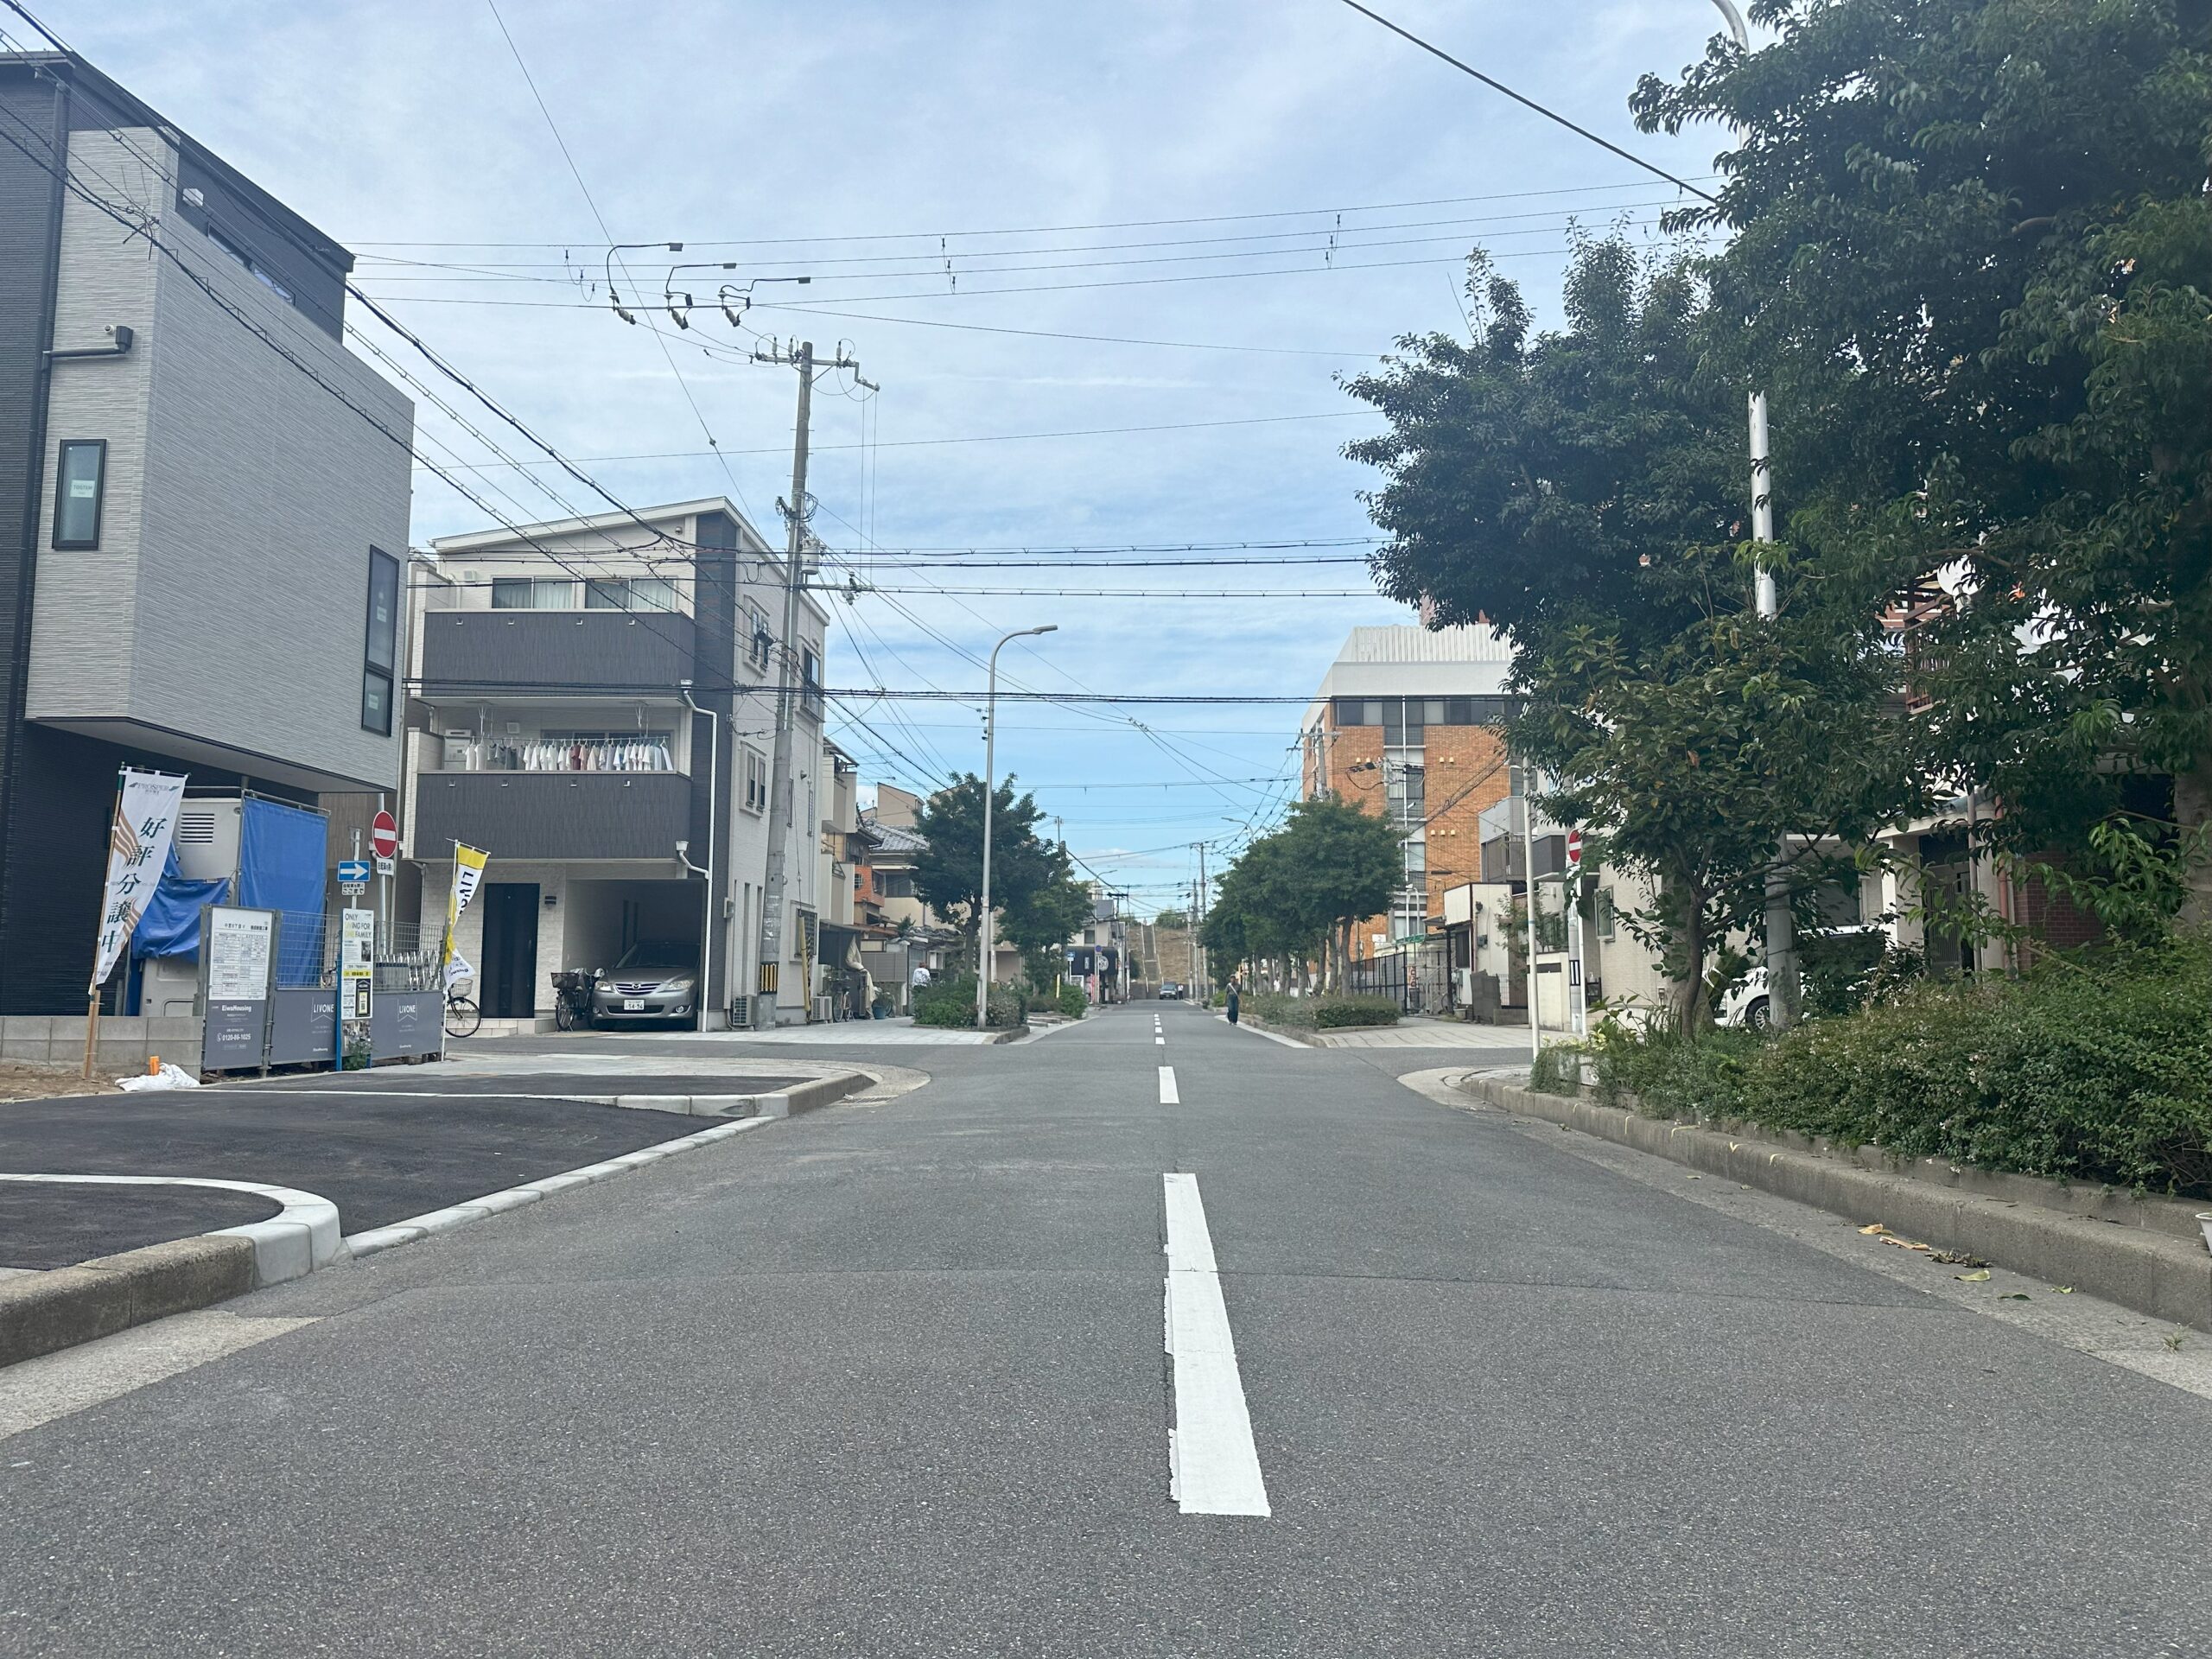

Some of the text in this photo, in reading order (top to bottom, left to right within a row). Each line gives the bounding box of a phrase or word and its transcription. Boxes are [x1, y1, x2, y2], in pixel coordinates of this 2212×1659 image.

[102, 817, 167, 953] 好評分譲中
[313, 1004, 334, 1014] LIVONE
[398, 1005, 416, 1014] LIVONE
